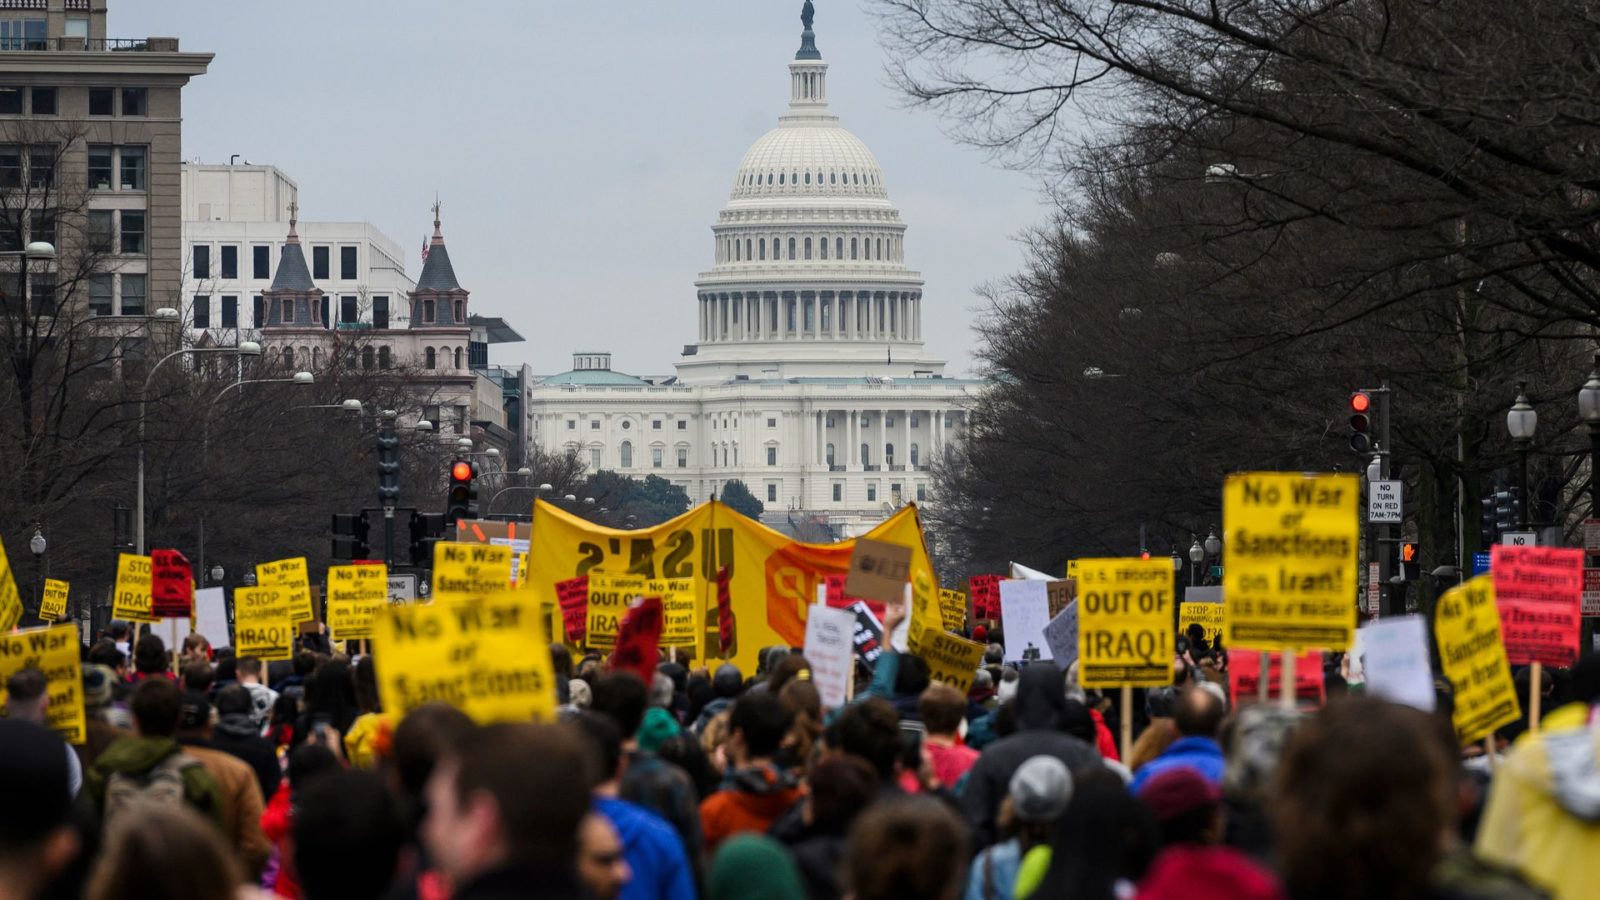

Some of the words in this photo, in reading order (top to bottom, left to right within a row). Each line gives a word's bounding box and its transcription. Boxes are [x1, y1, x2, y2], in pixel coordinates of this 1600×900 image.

[1242, 478, 1281, 508] No
[1290, 478, 1344, 507] War
[1280, 511, 1304, 528] or
[1234, 528, 1350, 559] Sanctions
[1513, 537, 1525, 546] NO
[444, 547, 468, 563] No
[472, 548, 505, 563] War
[128, 559, 152, 574] STO
[263, 566, 279, 576] No
[281, 561, 301, 572] War
[336, 570, 353, 580] No
[357, 568, 381, 579] War
[464, 565, 480, 577] or
[1115, 569, 1169, 582] TROOPS
[1239, 573, 1270, 592] on
[1278, 565, 1343, 592] Iran!
[648, 582, 664, 592] No
[667, 580, 690, 591] War
[45, 589, 57, 598] OUT
[57, 591, 67, 599] OF
[245, 591, 280, 606] STOP
[333, 589, 385, 601] Sanctions
[590, 591, 619, 606] OUT
[942, 591, 951, 599] No
[953, 592, 963, 601] War
[43, 601, 65, 614] IRAQ!
[1085, 591, 1132, 614] OUT
[1138, 591, 1168, 614] OF
[1187, 605, 1209, 615] STOP
[392, 608, 442, 640] No
[451, 602, 522, 632] War
[1181, 615, 1213, 623] BOMBING
[28, 632, 67, 653] War
[240, 626, 286, 647] IRAQ!
[932, 635, 972, 656] STOP
[1085, 630, 1166, 665] IRAQ!
